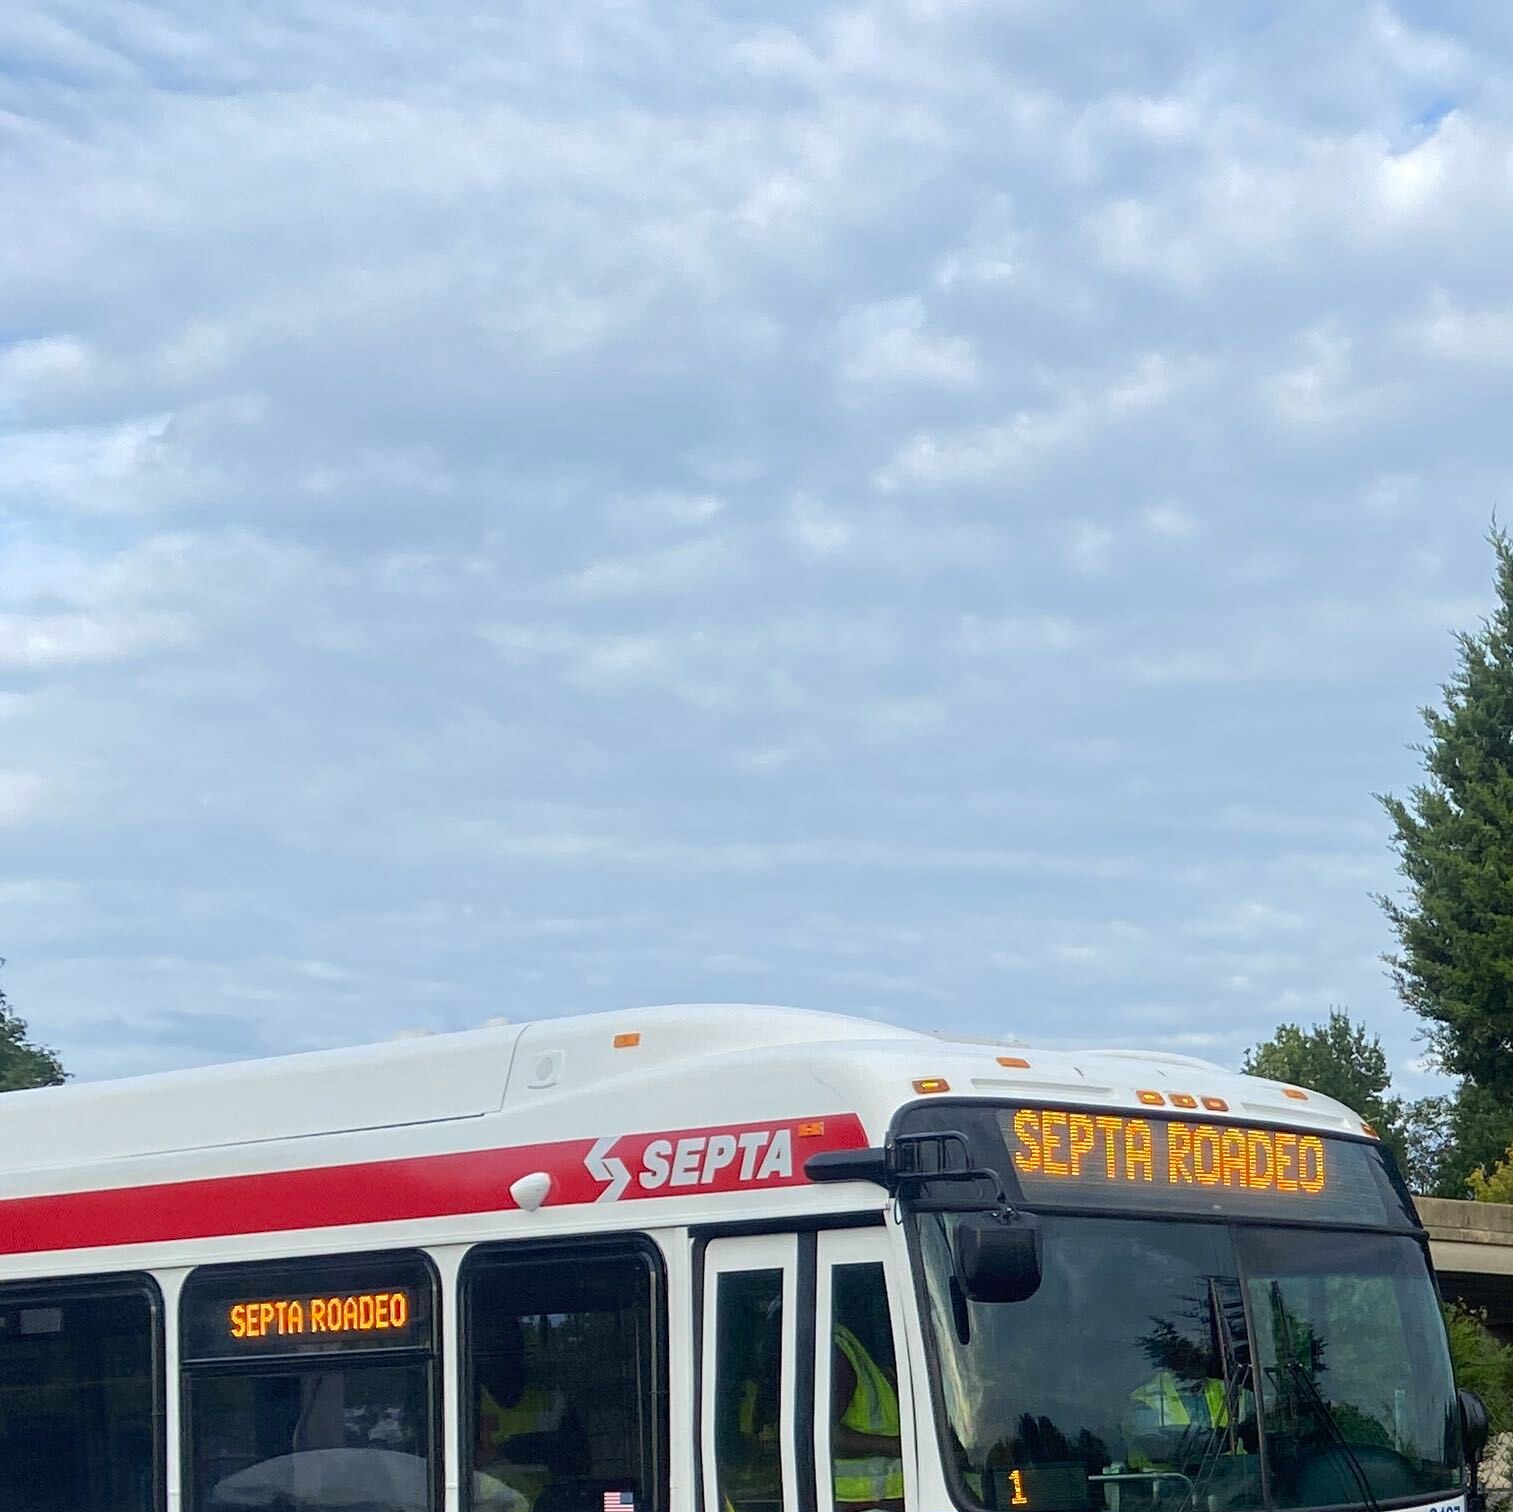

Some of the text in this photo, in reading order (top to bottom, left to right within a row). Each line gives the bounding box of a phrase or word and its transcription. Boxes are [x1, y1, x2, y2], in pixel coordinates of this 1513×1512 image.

[638, 1128, 793, 1190] SEPTA
[1013, 1109, 1325, 1194] SEPTA ROADEO
[230, 1293, 408, 1337] SEPTA ROADEO
